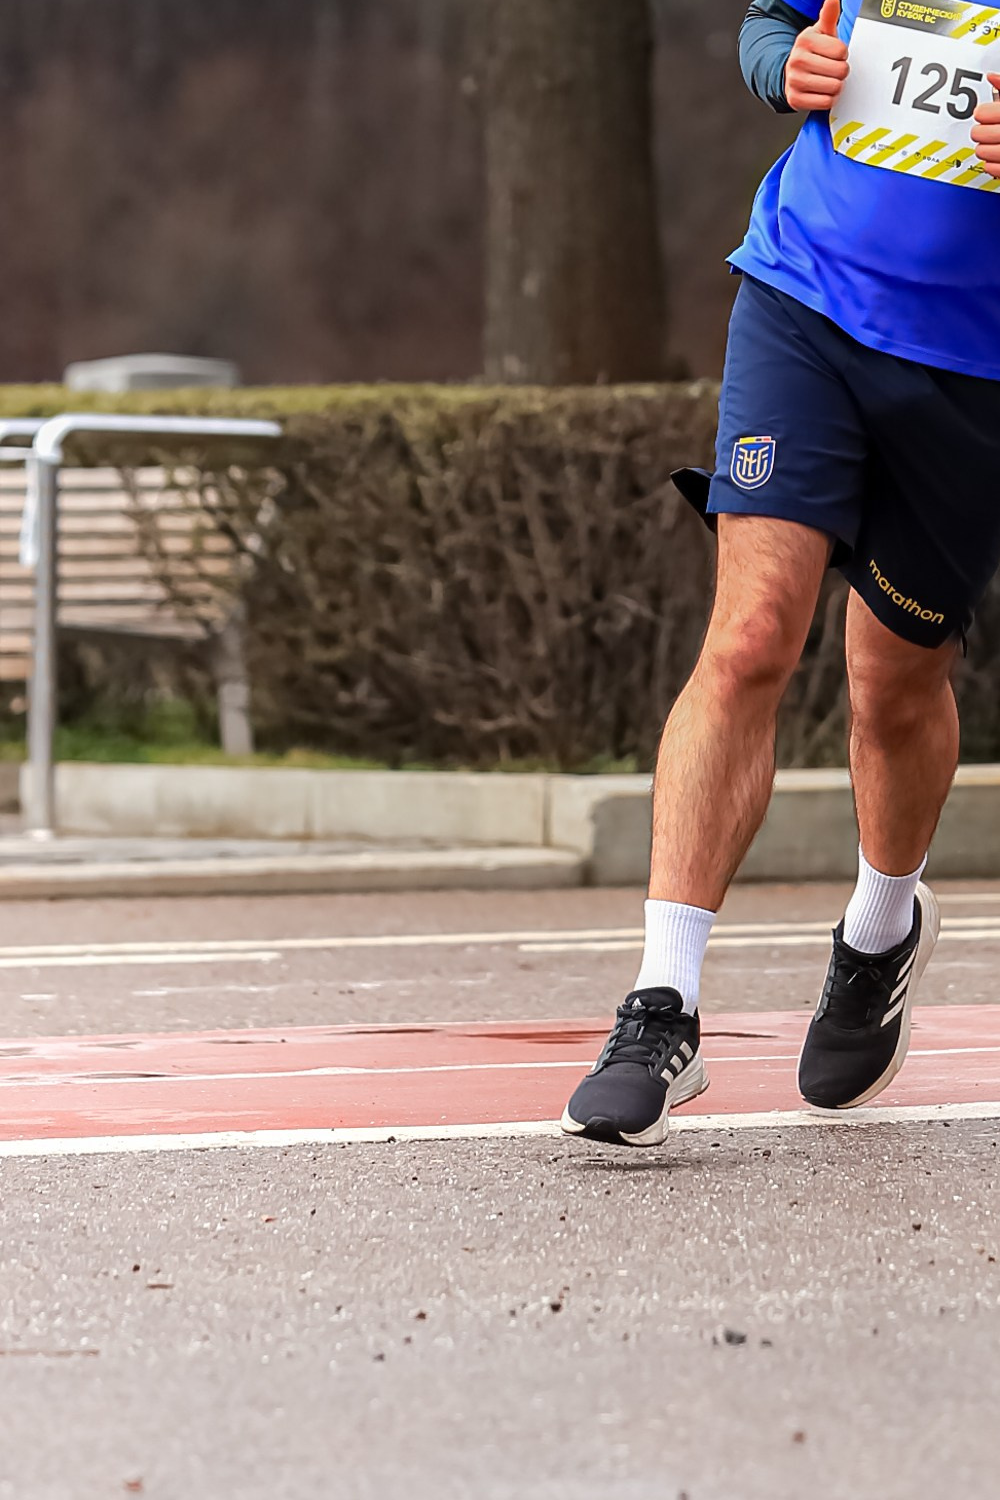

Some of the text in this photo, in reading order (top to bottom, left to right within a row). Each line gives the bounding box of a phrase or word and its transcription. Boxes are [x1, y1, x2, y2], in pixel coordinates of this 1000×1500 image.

[896, 9, 937, 24] КУБОК БС
[898, 1, 962, 20] СТУДЕНЧЕСКИЙ
[969, 22, 977, 32] 3
[891, 56, 983, 120] 125
[869, 559, 944, 624] marathon
